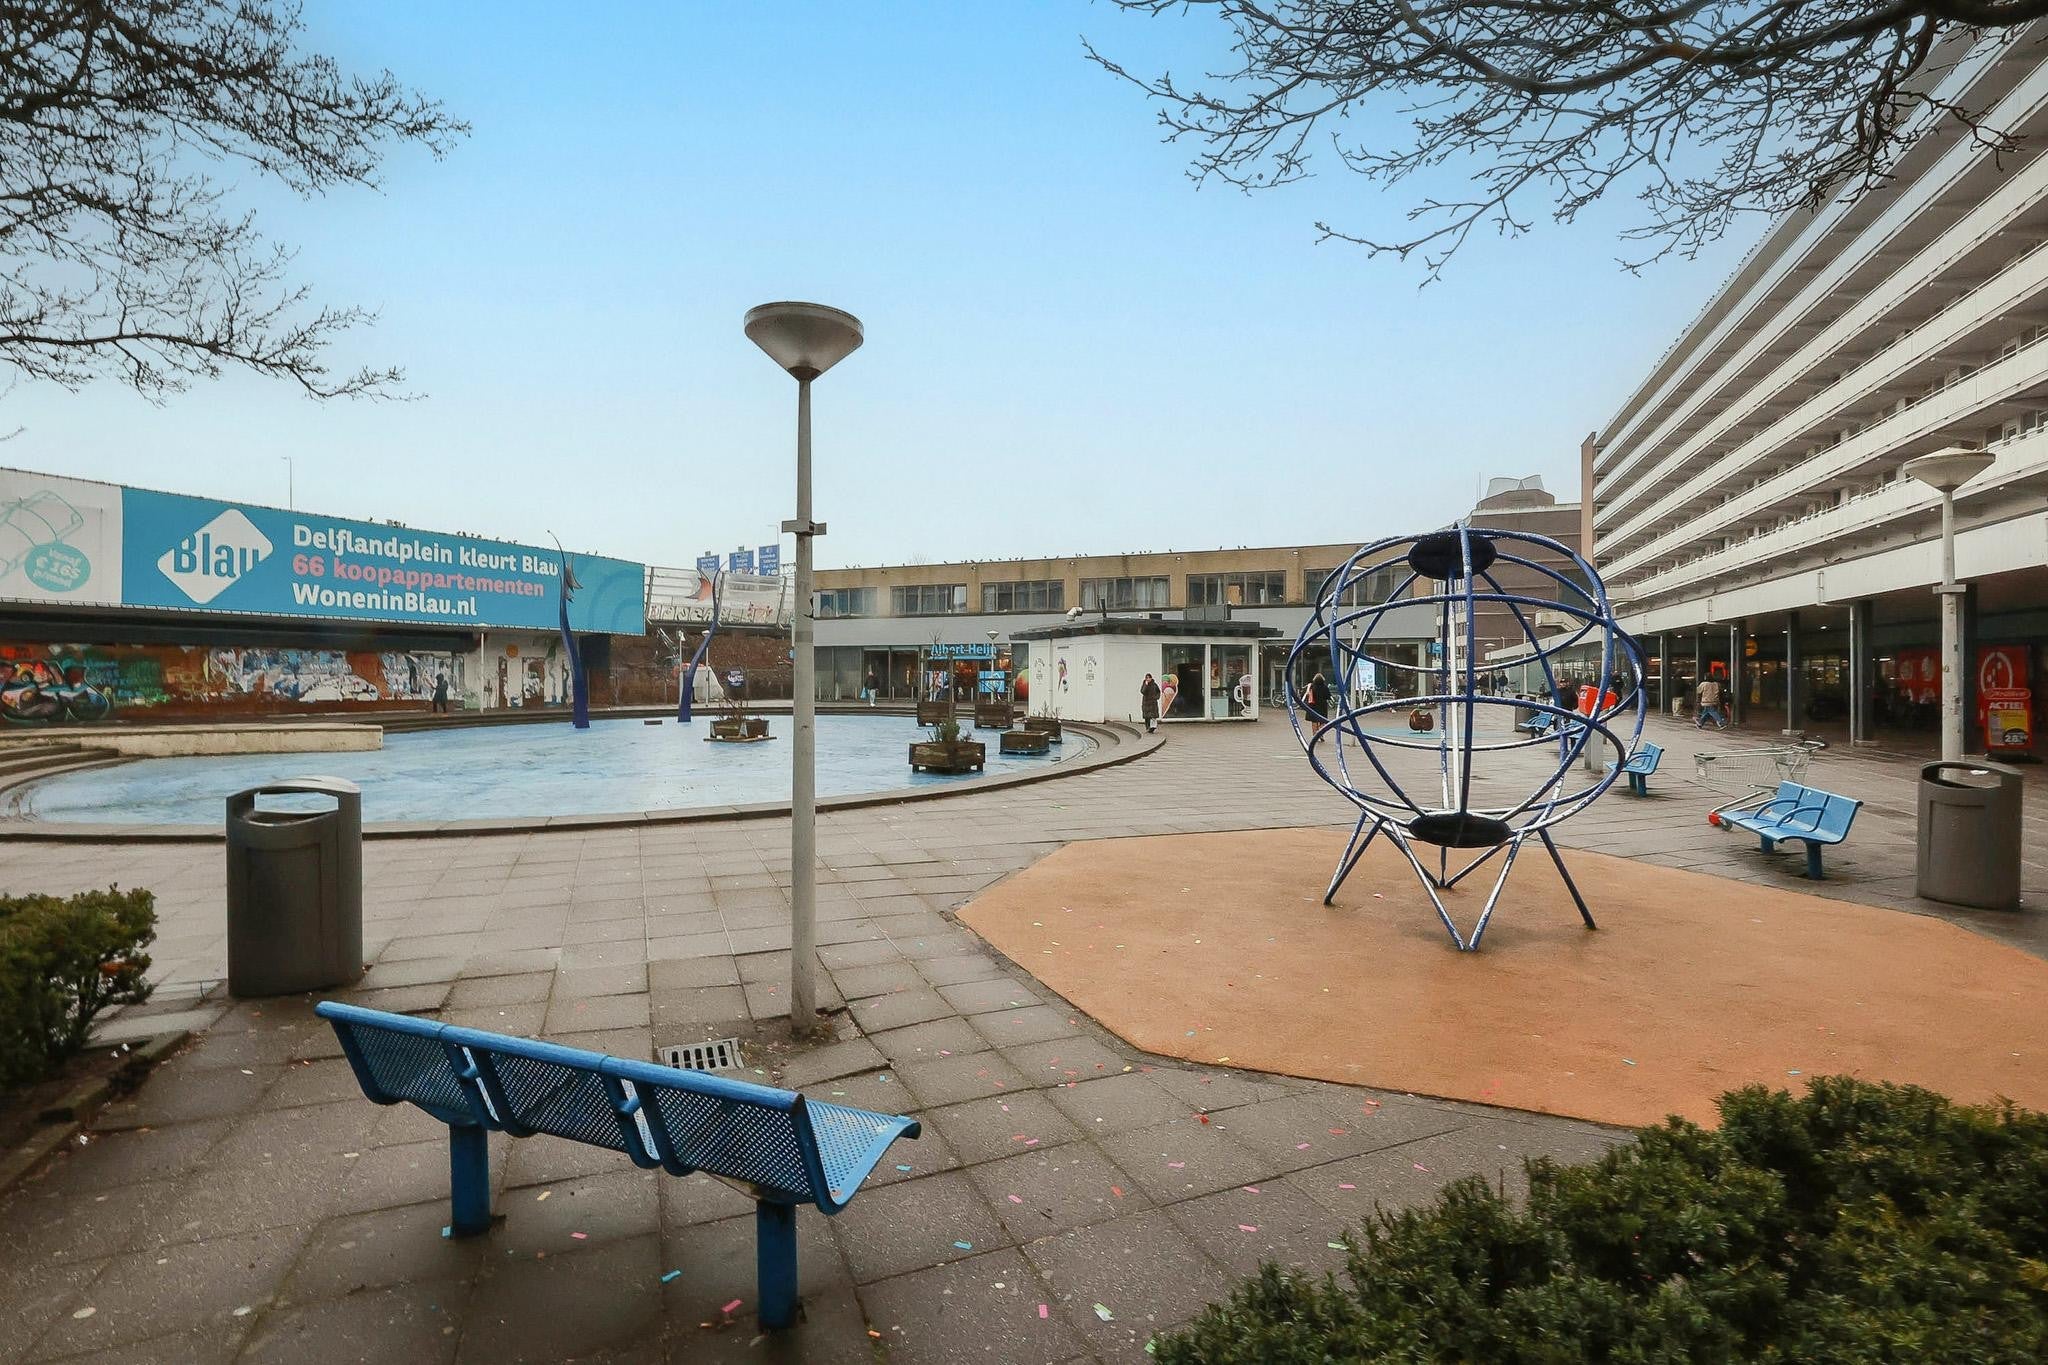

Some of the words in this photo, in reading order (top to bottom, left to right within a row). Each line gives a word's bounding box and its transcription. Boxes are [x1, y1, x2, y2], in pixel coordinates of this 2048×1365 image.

[173, 531, 260, 579] Blau
[293, 524, 453, 564] Delflandplein
[459, 546, 517, 572] kleurt
[522, 555, 559, 577] Blau
[292, 553, 325, 577] 66
[333, 556, 545, 598] koopappartementen
[292, 582, 477, 616] WoneninBlau.nl
